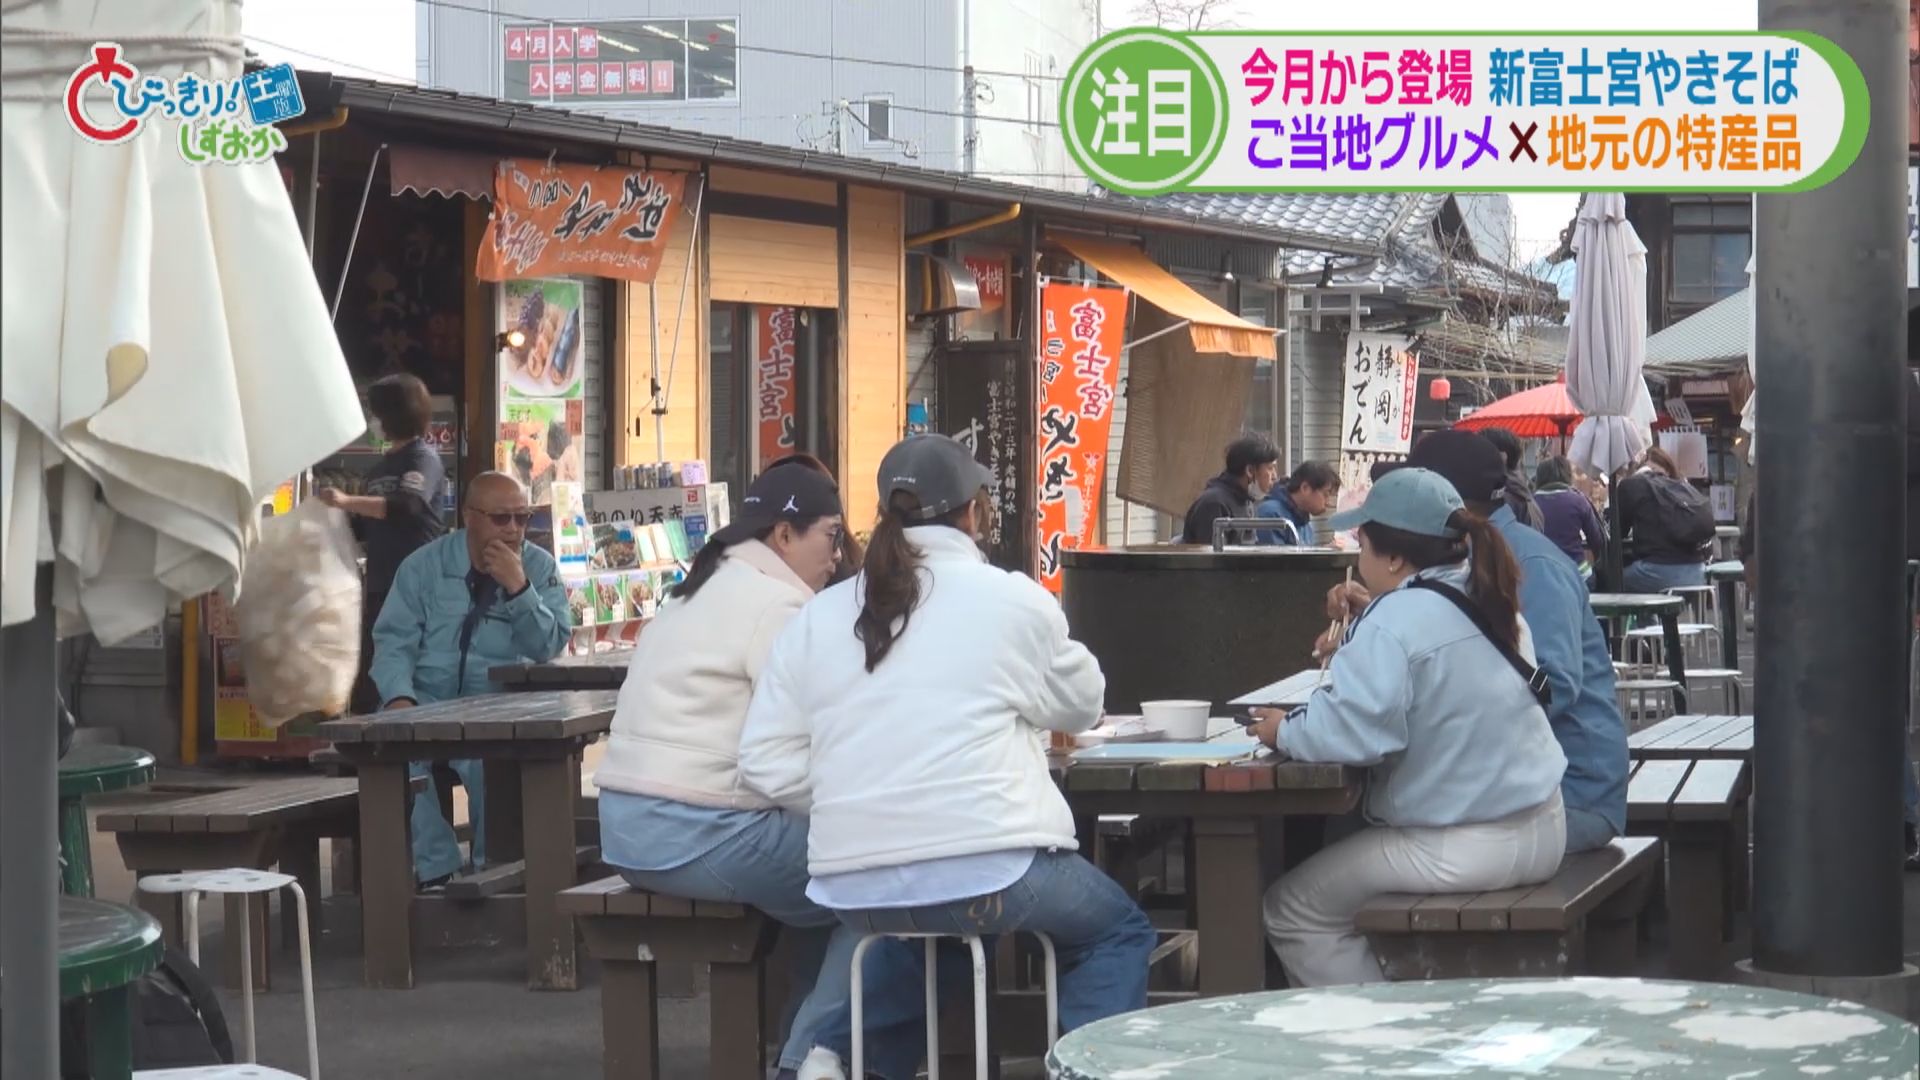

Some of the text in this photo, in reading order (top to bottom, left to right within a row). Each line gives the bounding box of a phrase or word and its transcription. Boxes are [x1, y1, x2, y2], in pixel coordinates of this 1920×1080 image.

[510, 34, 597, 54] 4月入学
[1071, 300, 1113, 419] 富士宮
[1349, 340, 1371, 445] おでん
